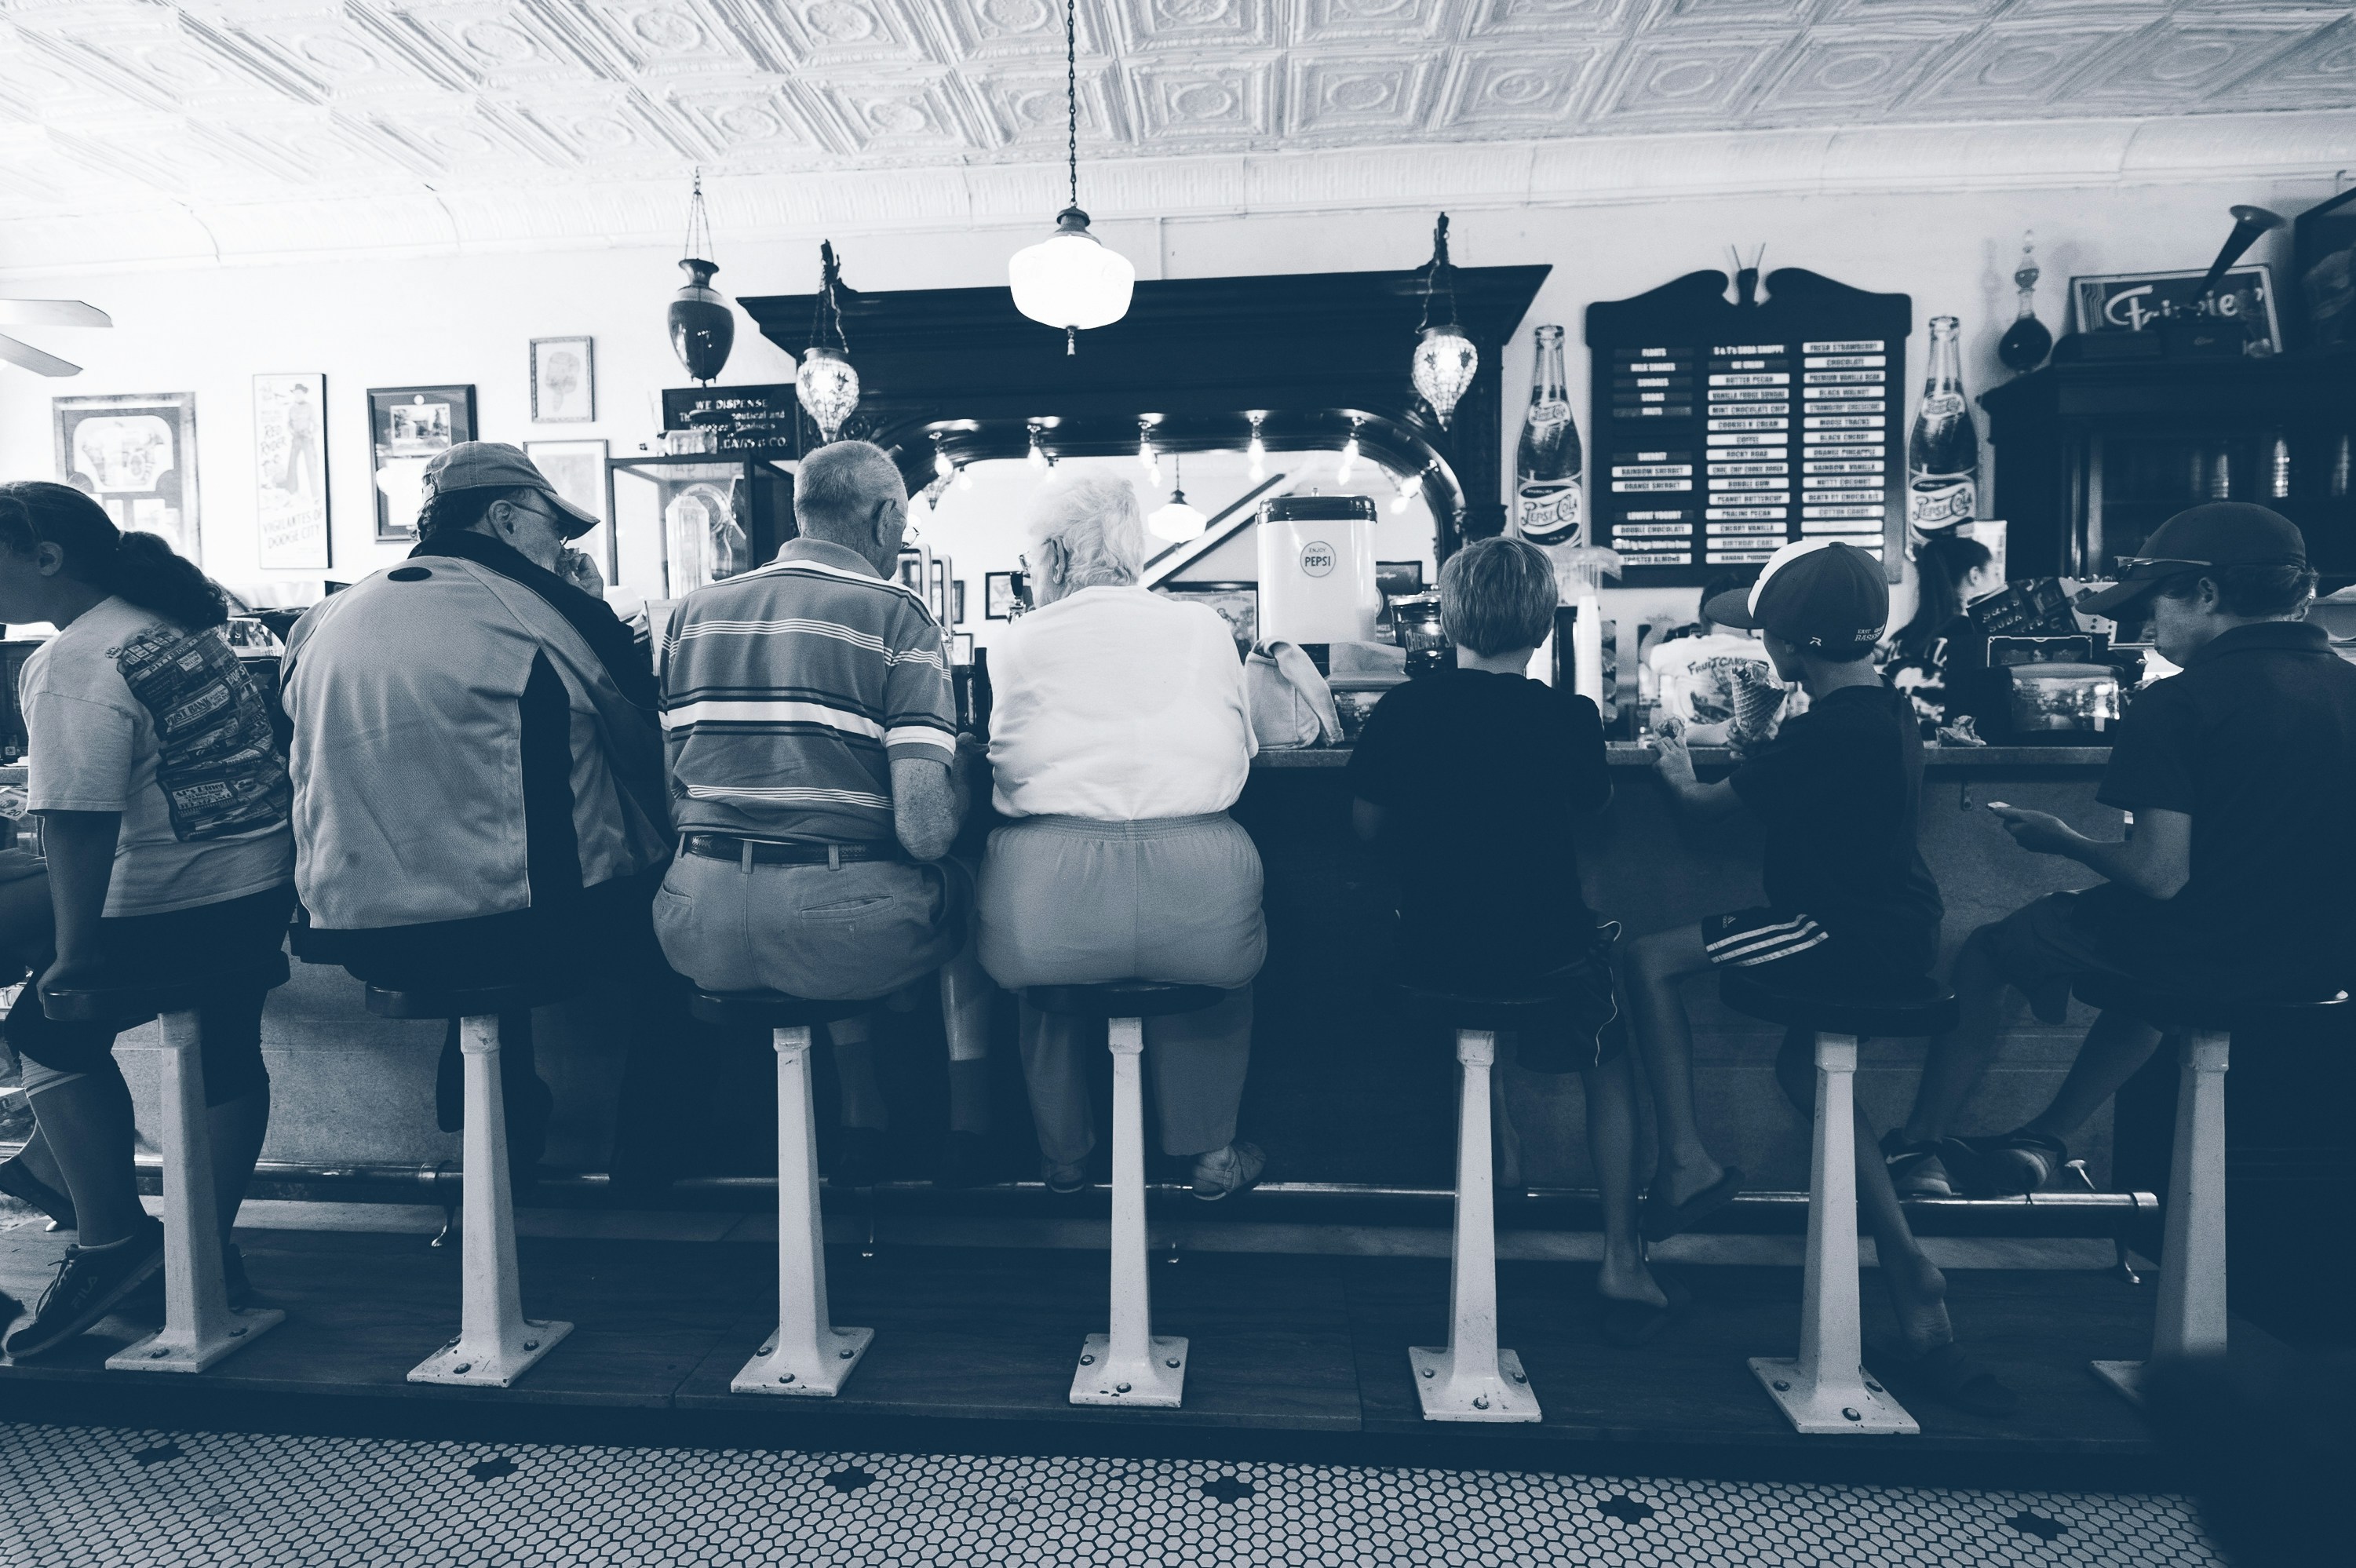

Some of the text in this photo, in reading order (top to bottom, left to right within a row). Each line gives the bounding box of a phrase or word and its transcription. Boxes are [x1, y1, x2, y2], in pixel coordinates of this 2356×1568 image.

[1758, 345, 1784, 354] SHOPPE
[1833, 343, 1877, 352] STRAWBERRY
[1825, 358, 1865, 366] CHOCOLATE
[1637, 378, 1669, 387] SUNDAES
[695, 399, 768, 410] WE DISPENSE
[768, 436, 788, 447] CO.
[1620, 525, 1685, 534] DOUBLE CHOCOLATE
[268, 524, 320, 549] DODGE CITY
[1304, 556, 1331, 567] PEPSI
[187, 696, 213, 715] BANK
